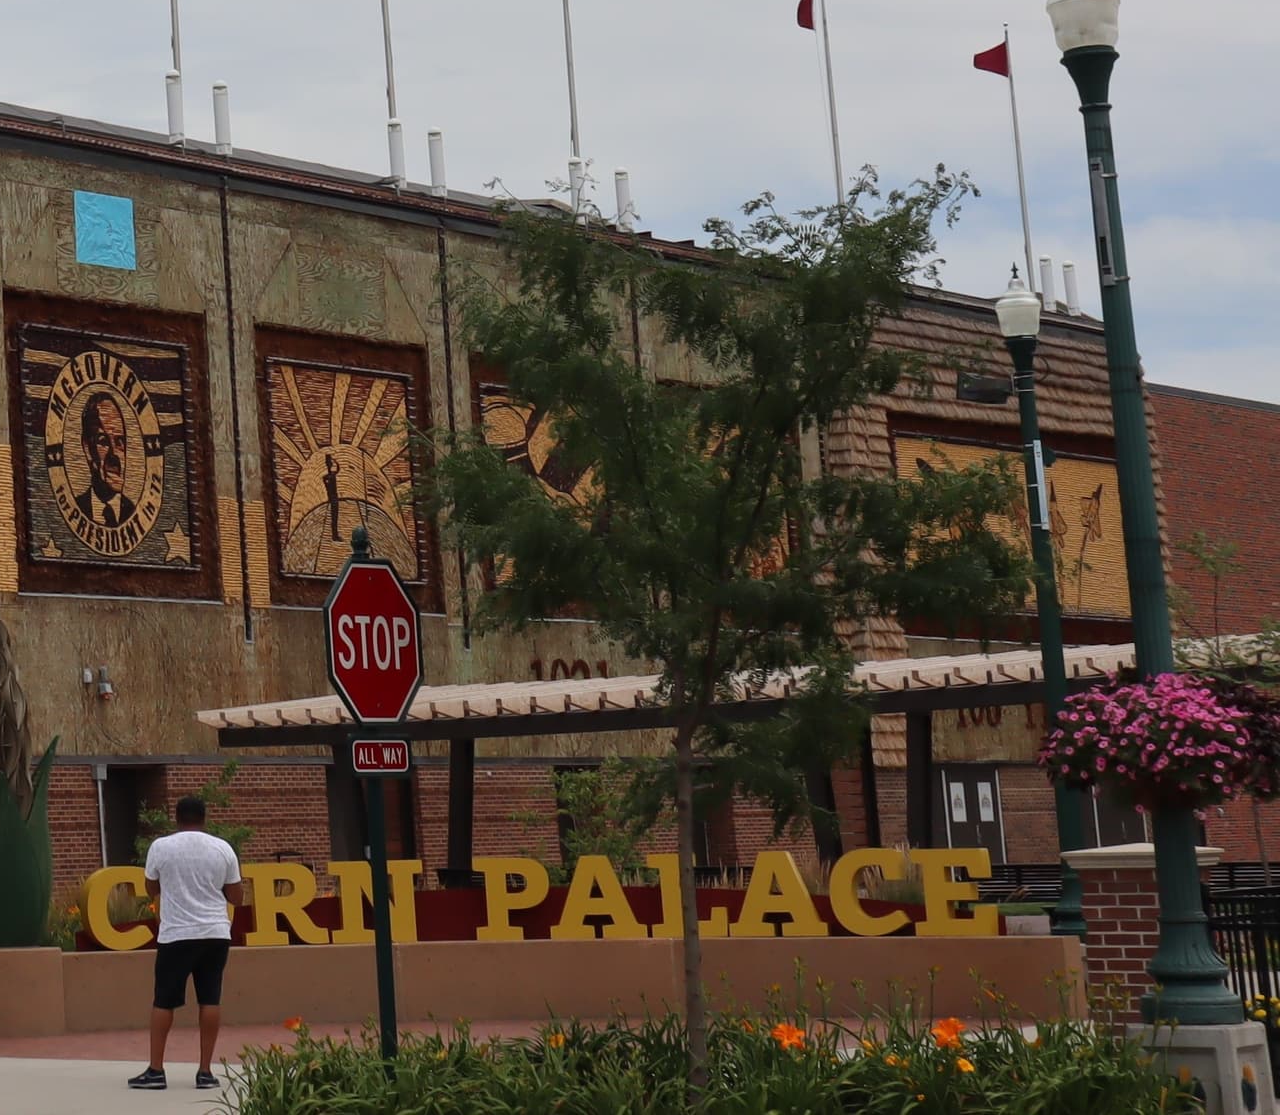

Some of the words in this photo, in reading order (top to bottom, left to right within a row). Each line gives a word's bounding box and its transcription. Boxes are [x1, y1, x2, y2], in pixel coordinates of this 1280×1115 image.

[68, 507, 145, 553] PRESIDENT
[338, 614, 410, 670] STOP
[358, 748, 377, 764] ALL
[383, 748, 402, 764] WAY
[80, 860, 423, 951] CRN
[472, 848, 1000, 940] PALACE
